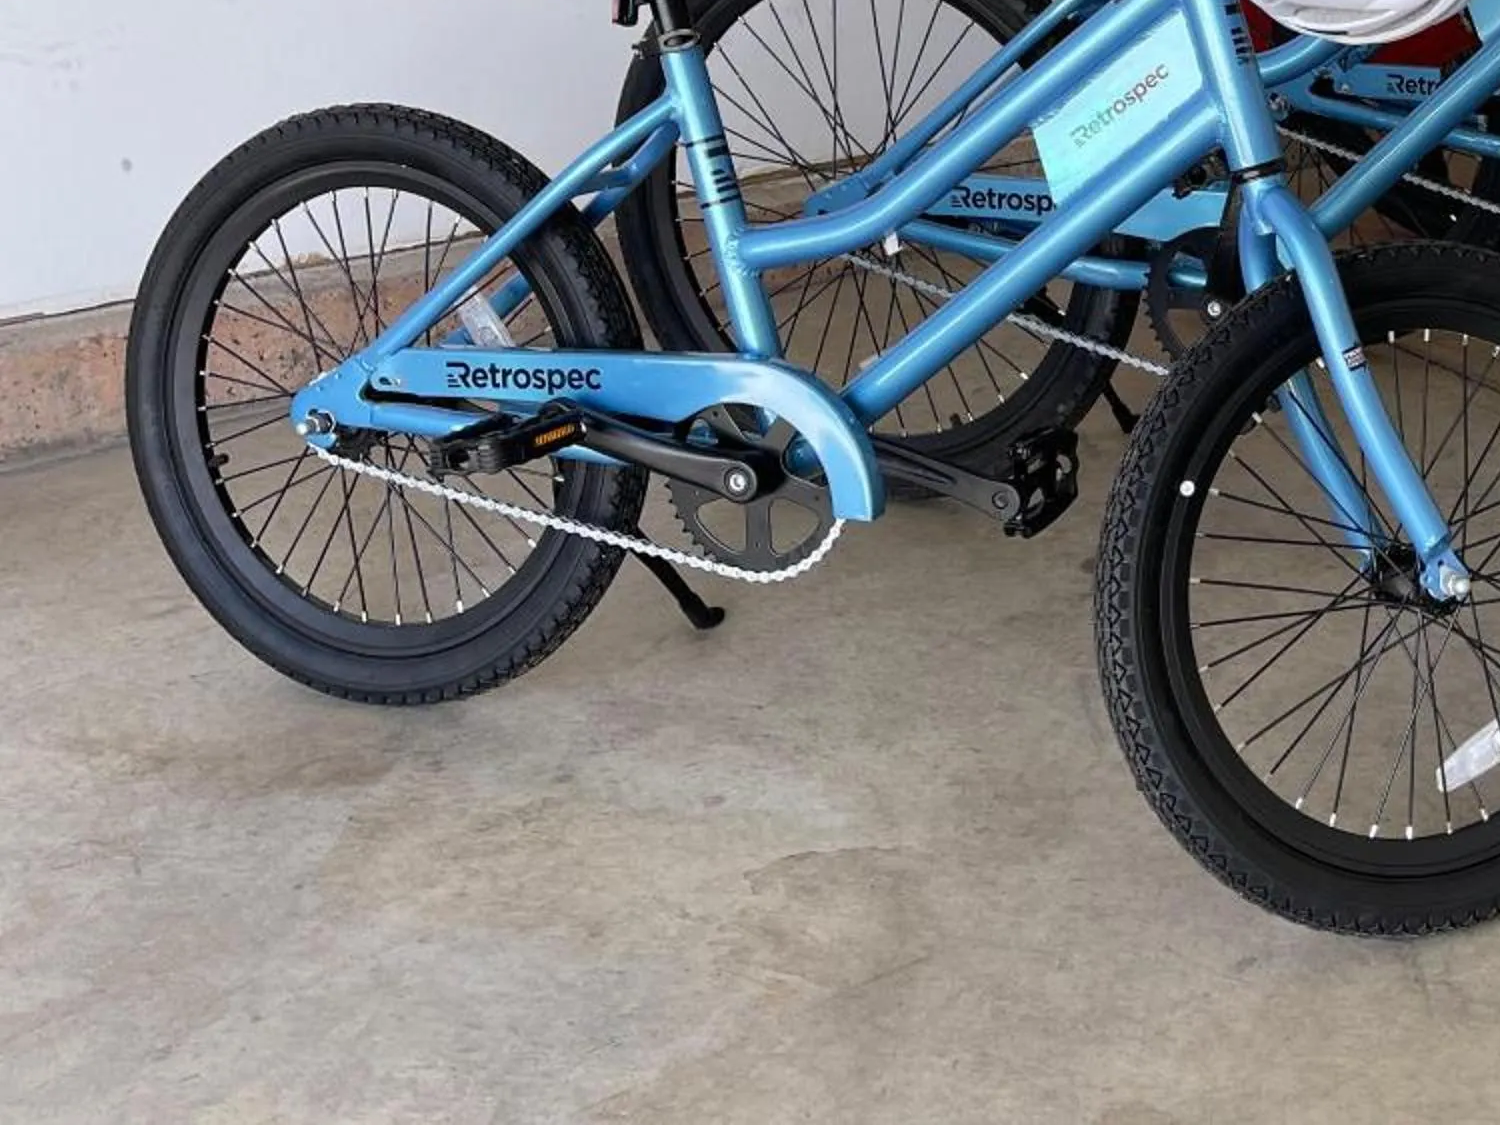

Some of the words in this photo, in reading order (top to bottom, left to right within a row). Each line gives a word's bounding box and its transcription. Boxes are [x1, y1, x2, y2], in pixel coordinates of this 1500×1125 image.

[1069, 62, 1169, 149] Retrospec
[951, 185, 1057, 217] Retrosp
[446, 361, 603, 395] Retrospec
